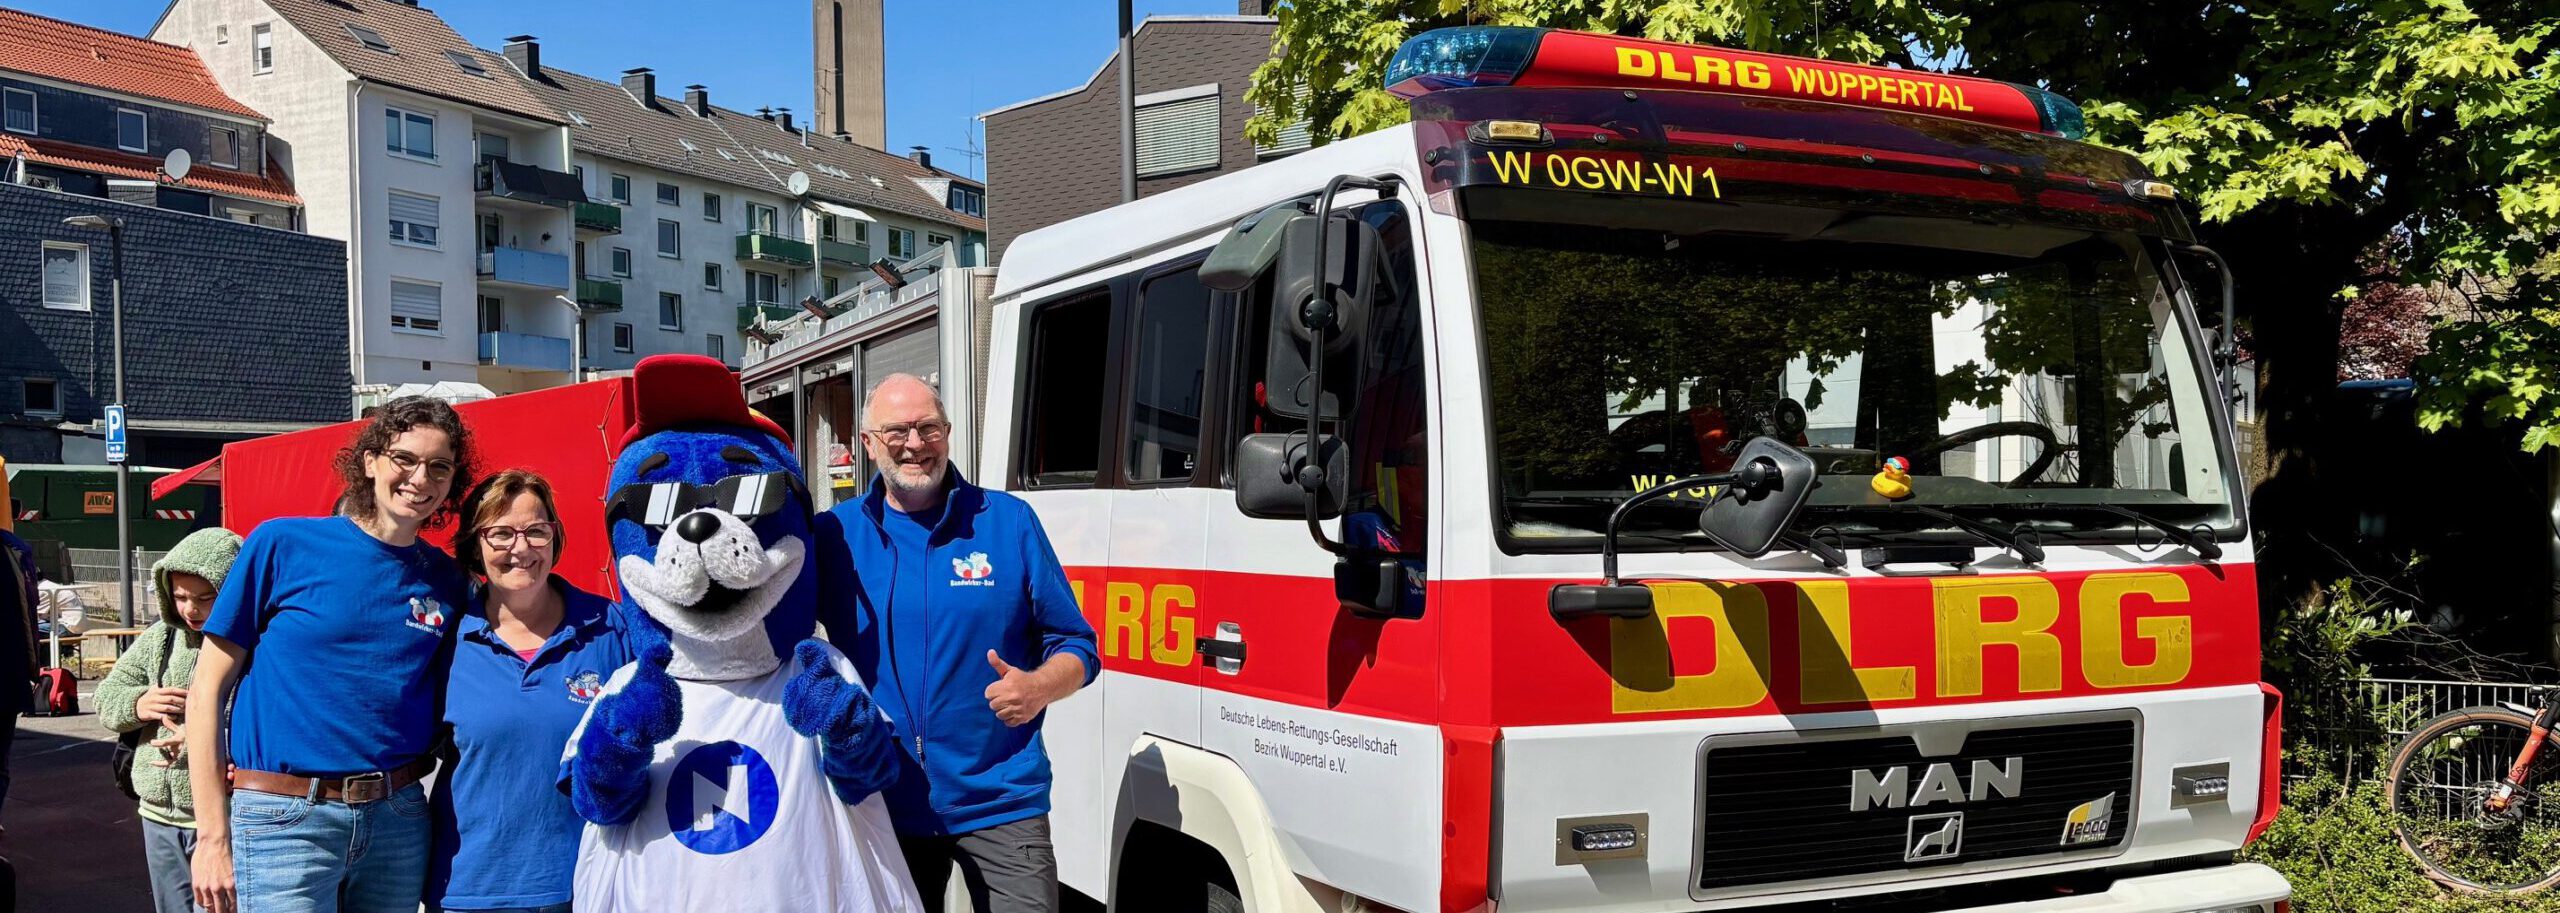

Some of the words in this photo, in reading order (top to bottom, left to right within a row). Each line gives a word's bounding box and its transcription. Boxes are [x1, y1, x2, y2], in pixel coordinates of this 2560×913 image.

[1616, 47, 1771, 89] DLRG
[1785, 66, 1974, 112] WUPPERTAL
[1487, 151, 1531, 184] W
[109, 410, 121, 440] P
[1611, 572, 2192, 714] DLRG
[1220, 706, 1255, 727] Deutsche
[1256, 714, 1398, 756] Lebens-Rettungs-Gesellschaft
[1254, 739, 1279, 757] Bezirk
[1279, 744, 1327, 769] Wuppertal
[1329, 757, 1348, 774] e.V.
[1850, 757, 2023, 811] MAN
